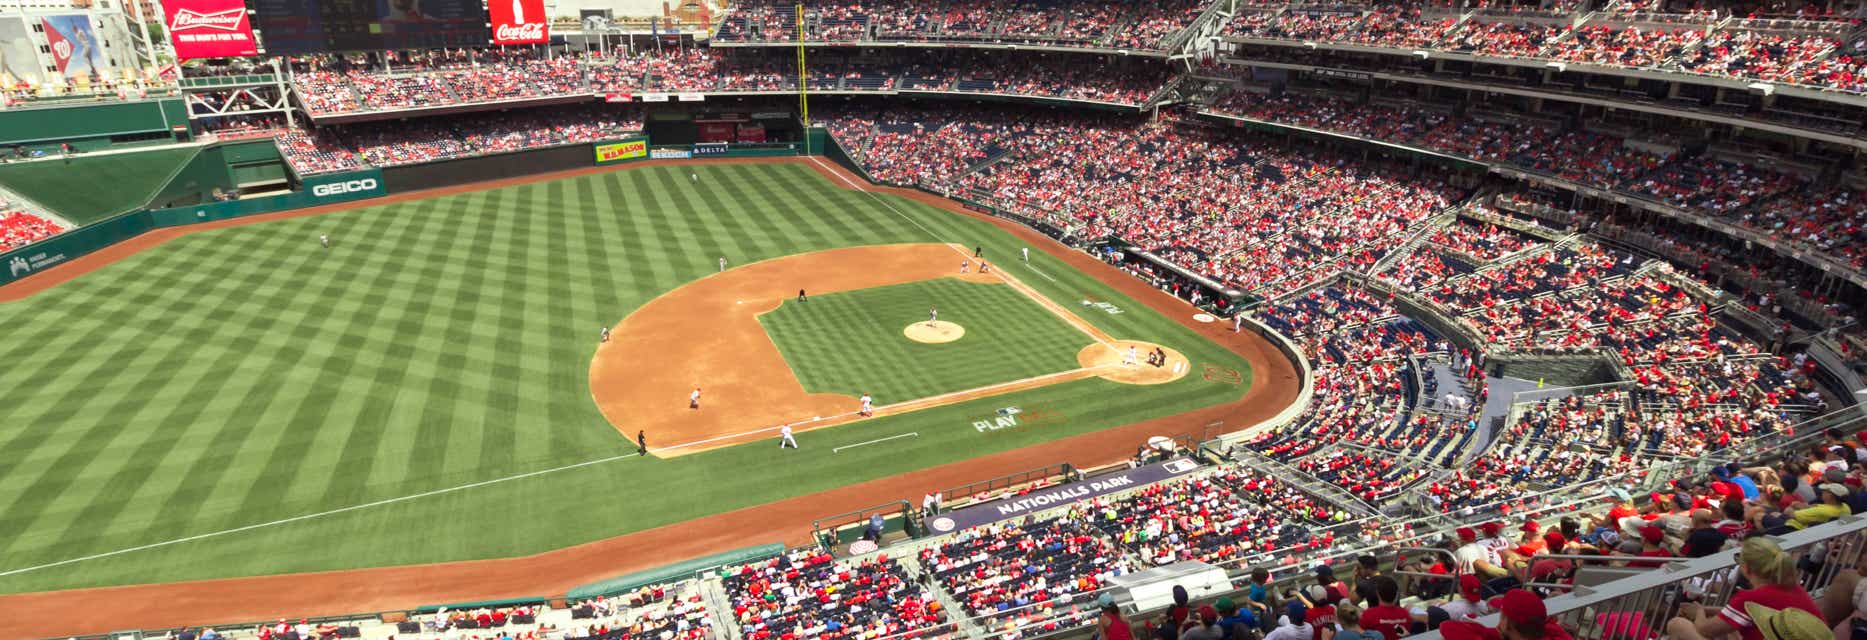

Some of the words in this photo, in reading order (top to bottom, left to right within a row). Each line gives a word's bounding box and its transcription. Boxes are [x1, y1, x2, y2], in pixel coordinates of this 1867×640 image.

[174, 13, 241, 25] Budweiser
[178, 34, 195, 42] THIS
[217, 33, 231, 41] FOR
[312, 178, 377, 197] GEICO
[972, 415, 1017, 433] PLAY
[997, 485, 1090, 515] NATIONALS
[1090, 475, 1134, 492] PARK
